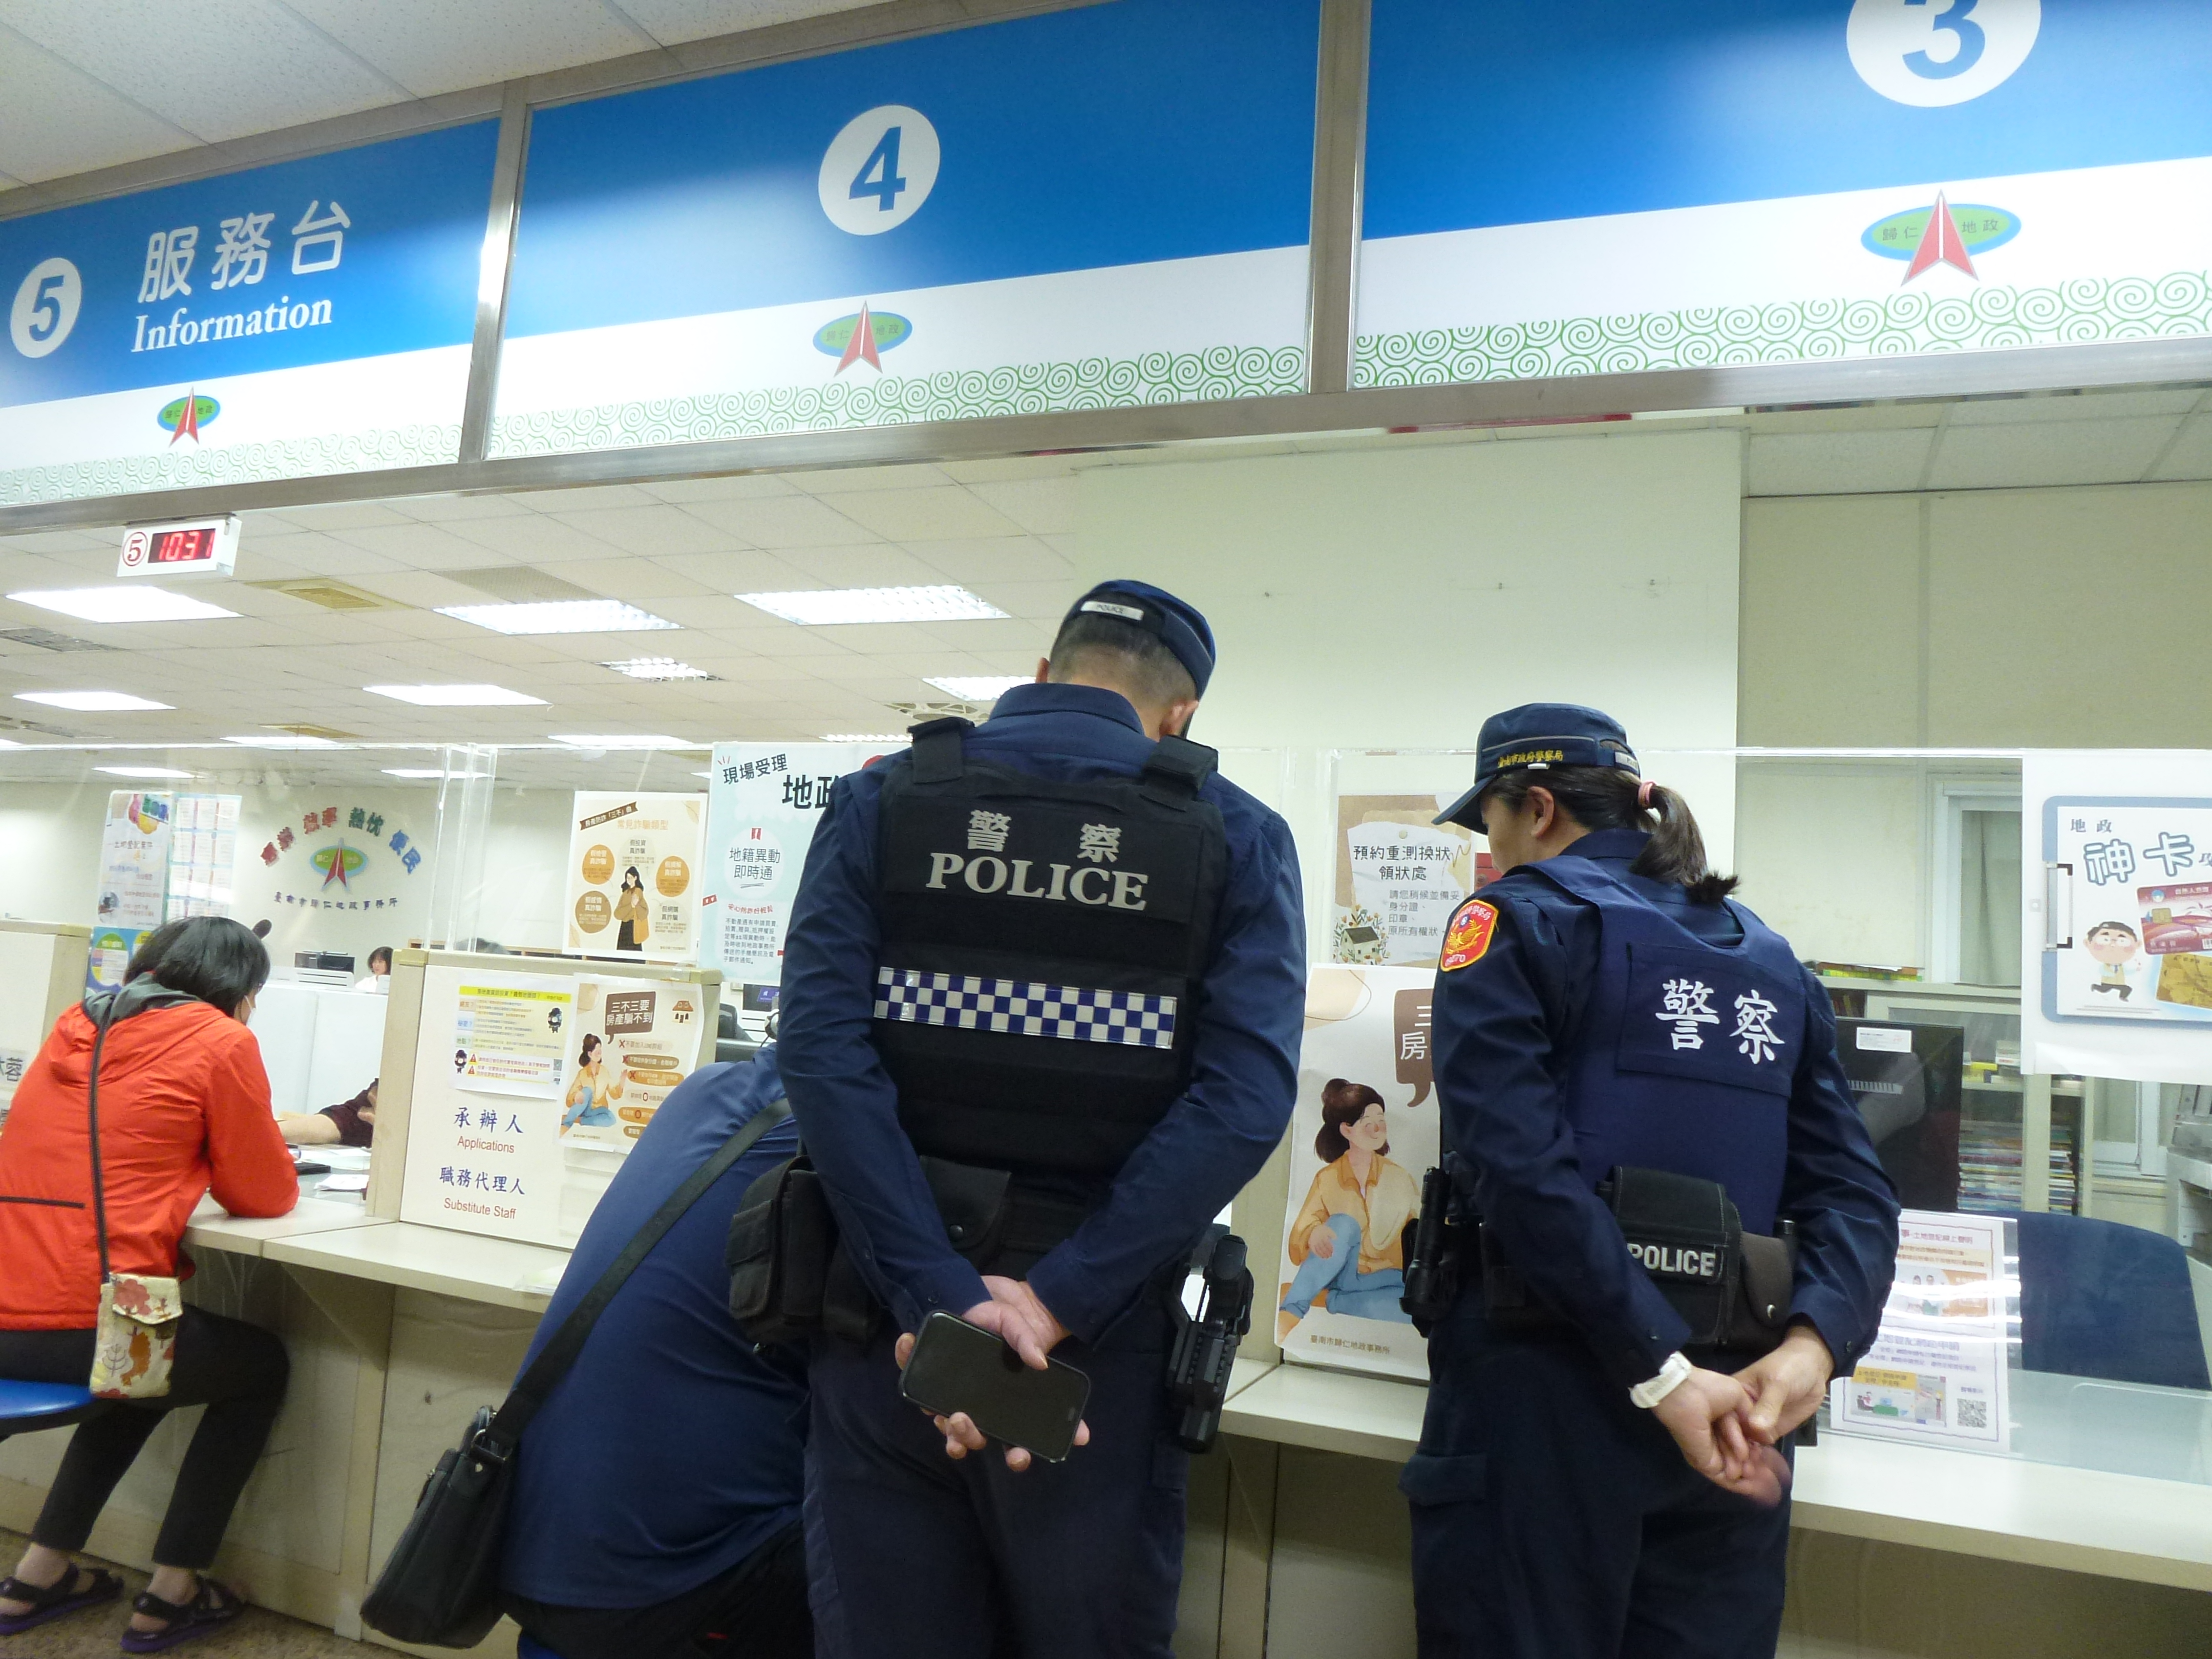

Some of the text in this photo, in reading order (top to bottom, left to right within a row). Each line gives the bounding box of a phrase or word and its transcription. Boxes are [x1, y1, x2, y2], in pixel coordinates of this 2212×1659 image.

[1902, 0, 1986, 79] 3
[848, 126, 906, 212] 4
[1882, 219, 1999, 242] 歸仁 地政
[137, 199, 351, 303] 服務台
[29, 274, 64, 343] 5
[131, 295, 333, 353] Information
[876, 324, 899, 336] 地政
[126, 534, 144, 563] 5
[158, 529, 213, 561] 1031
[723, 753, 788, 784] 現場受理
[967, 810, 1122, 863] 警察
[2071, 819, 2112, 833] 地政
[729, 847, 781, 863] 地籍異動
[1353, 845, 1451, 861] 預約重測換狀
[2083, 832, 2195, 885] 神卡
[734, 865, 773, 880] 即時通
[926, 853, 1148, 911] POLICE
[1378, 865, 1427, 881] 領狀處
[1389, 890, 1459, 900] 請您稍候並備妥
[606, 1012, 653, 1026] 房產騙不到
[611, 999, 650, 1012] 三不三要
[1655, 979, 1785, 1064] 警察
[1400, 1031, 1428, 1060] 房
[454, 1107, 524, 1134] 承辦人
[457, 1136, 515, 1154] Applications
[439, 1165, 525, 1195] 職務代理人
[443, 1198, 517, 1220] Substitute Staff
[1627, 1243, 1716, 1277] POLICE
